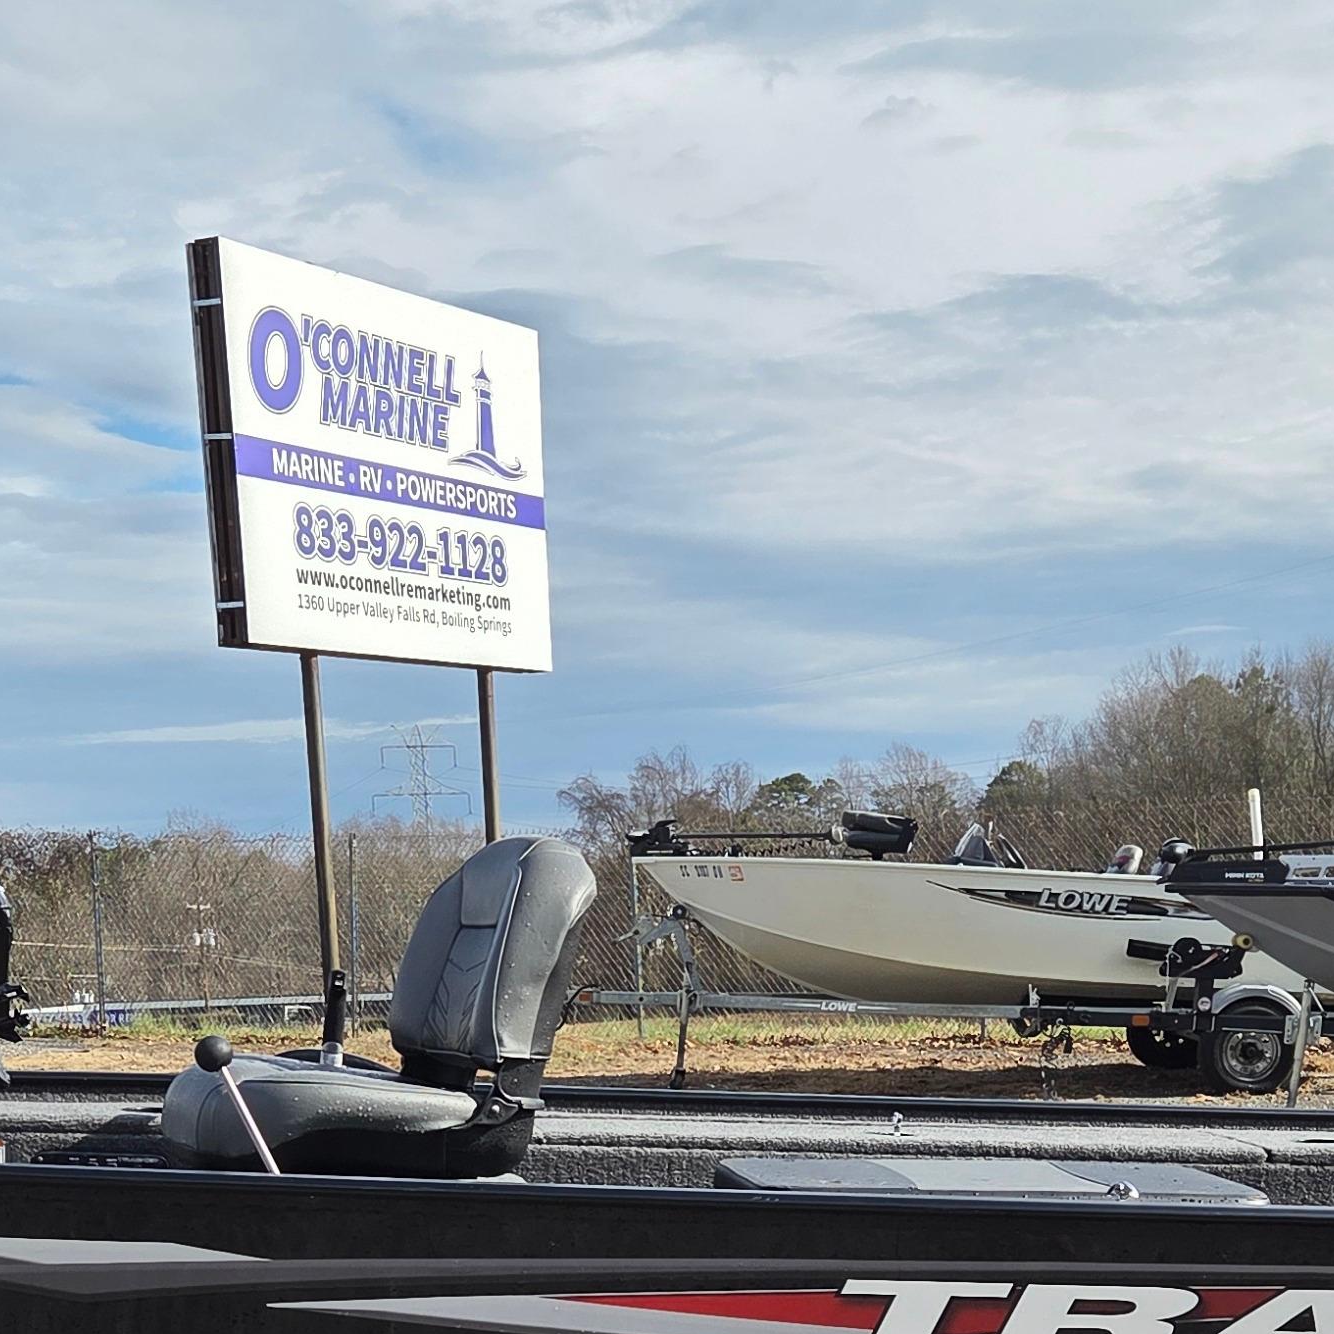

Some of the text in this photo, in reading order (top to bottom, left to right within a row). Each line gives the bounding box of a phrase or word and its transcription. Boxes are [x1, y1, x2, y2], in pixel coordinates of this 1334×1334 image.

[247, 305, 461, 414] O'CONNELL
[320, 373, 450, 452] MARINE
[272, 448, 517, 519] MARINE RV POWERSPORTS
[293, 502, 508, 587] 833-922-1128
[296, 568, 511, 611] www.oconnellremarketing.com
[297, 594, 512, 637] 1360 Upper Valley Falls Rd, Boiling Springs
[1037, 888, 1133, 914] LOWE
[820, 1001, 857, 1012] LOWE
